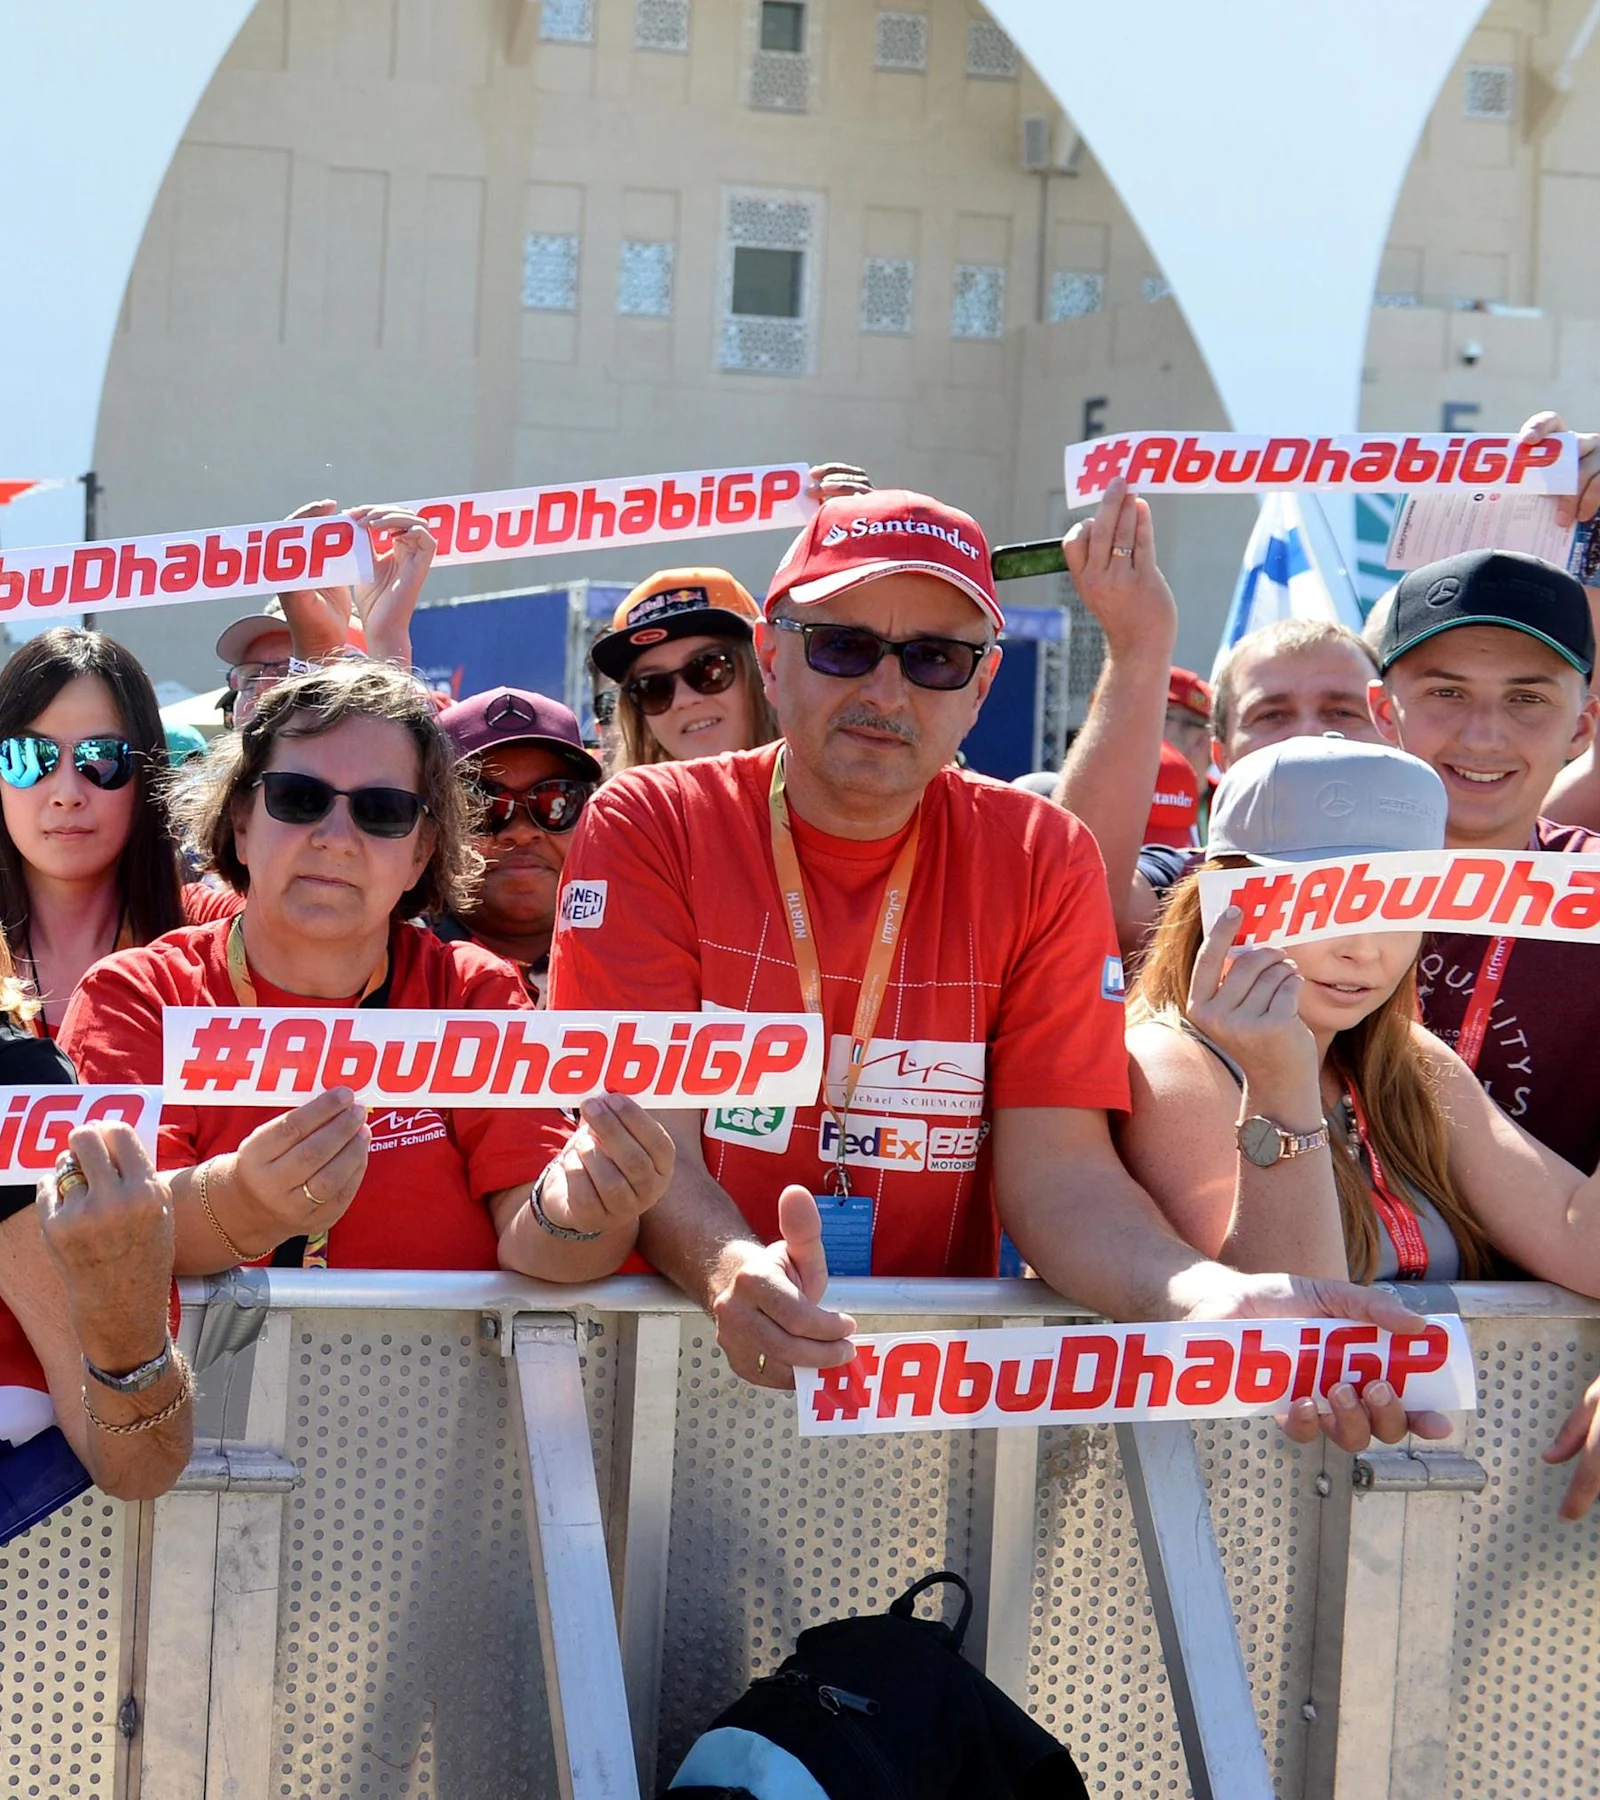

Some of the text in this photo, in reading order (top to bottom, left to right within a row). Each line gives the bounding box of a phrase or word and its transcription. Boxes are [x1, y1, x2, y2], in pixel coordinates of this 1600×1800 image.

[851, 517, 980, 561] Santander
[786, 892, 807, 939] NORTH
[179, 1016, 808, 1096] #AbuDhabiGP
[367, 1129, 447, 1152] ichael Schumac
[822, 1121, 923, 1162] FedEx
[815, 1324, 1449, 1422] #AbuDhabiGP
